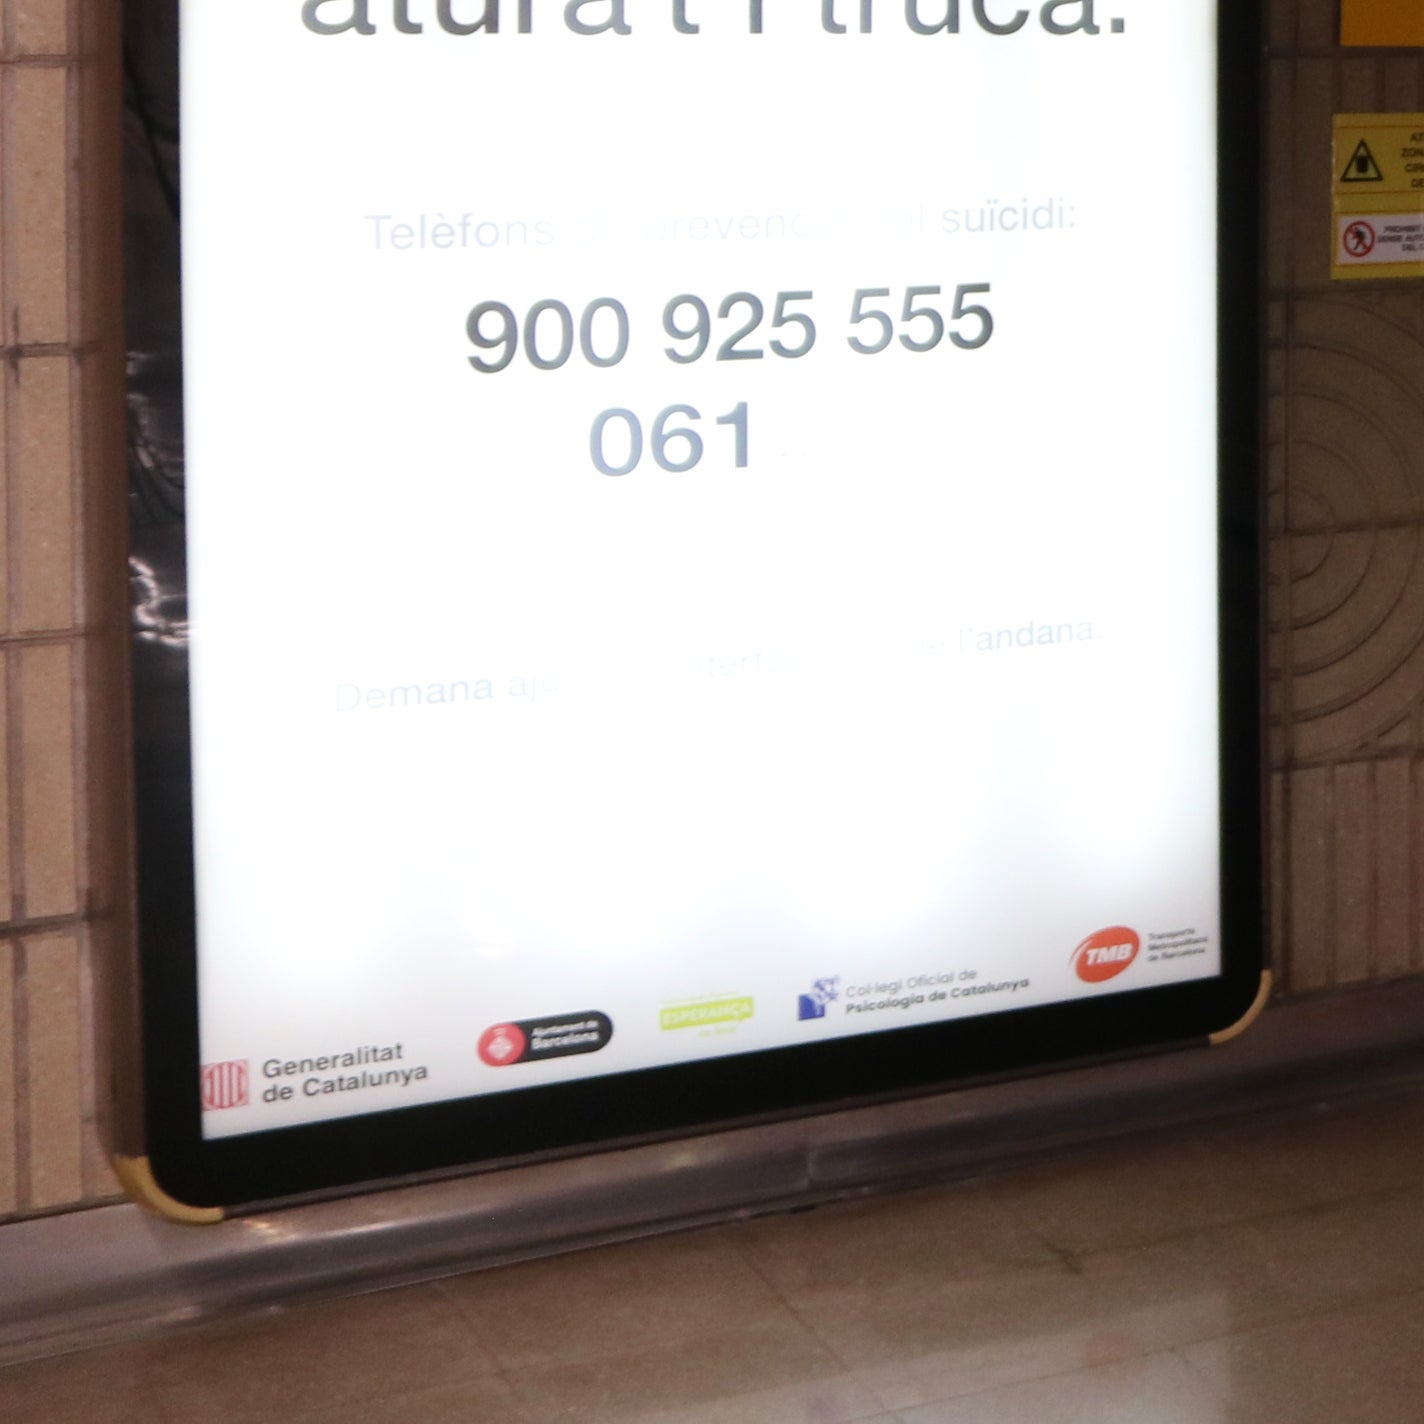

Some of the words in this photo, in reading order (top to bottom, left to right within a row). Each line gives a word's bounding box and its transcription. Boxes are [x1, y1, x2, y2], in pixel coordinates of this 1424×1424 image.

[364, 212, 555, 250] Telèfons
[941, 196, 1077, 233] suïcidi:
[465, 297, 629, 374] 900
[662, 290, 816, 364] 925
[847, 282, 994, 354] 555
[590, 402, 748, 476] 061
[1086, 943, 1132, 965] TMB
[928, 989, 946, 1001] de
[951, 978, 1029, 999] Catalunya
[262, 1043, 403, 1079] Generalitat
[262, 1084, 294, 1104] de
[302, 1064, 428, 1098] Catalunya
